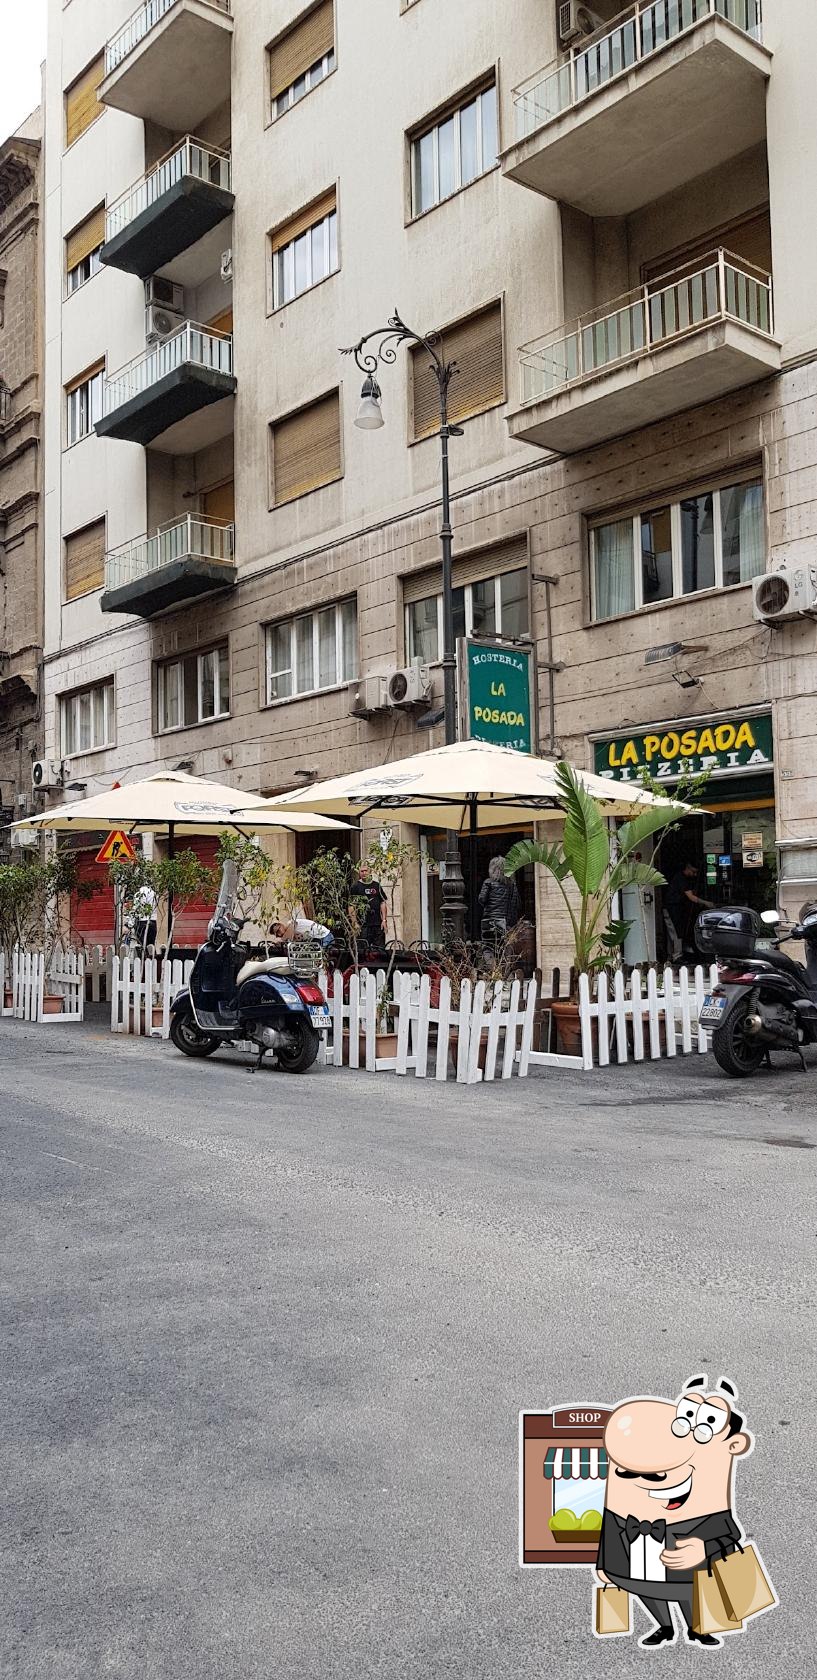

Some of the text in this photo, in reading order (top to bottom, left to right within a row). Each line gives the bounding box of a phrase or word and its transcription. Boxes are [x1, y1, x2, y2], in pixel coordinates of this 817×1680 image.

[472, 653, 523, 671] HOSTERIA
[490, 681, 506, 696] LA
[474, 706, 525, 727] POSADA
[608, 722, 756, 767] LA POSADA
